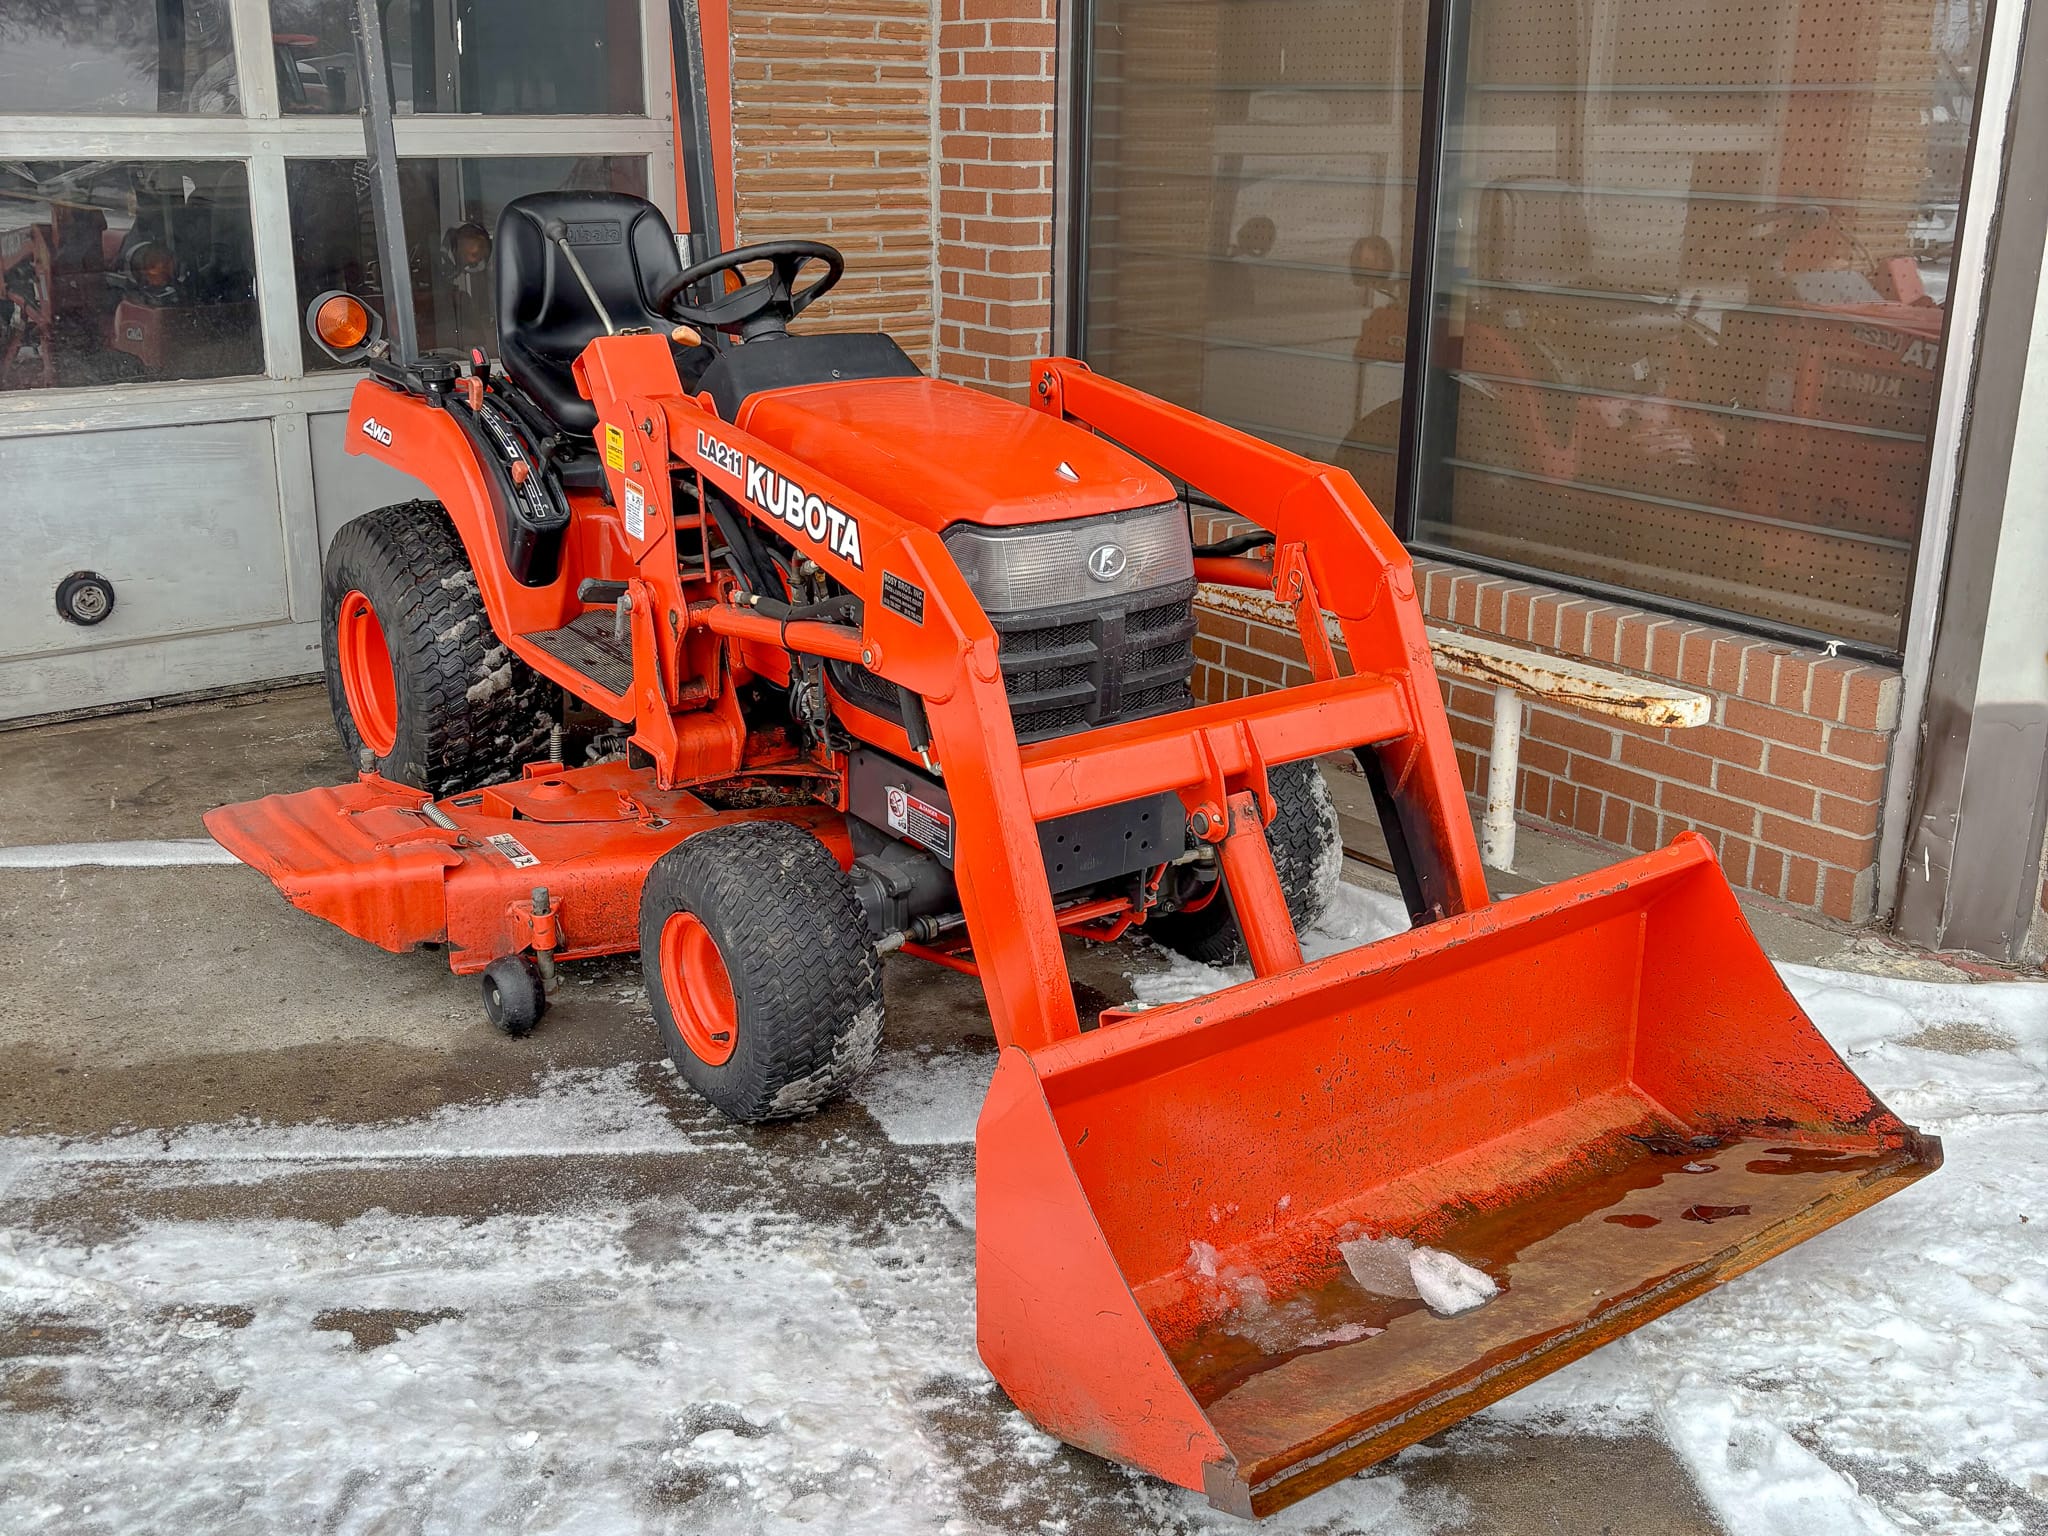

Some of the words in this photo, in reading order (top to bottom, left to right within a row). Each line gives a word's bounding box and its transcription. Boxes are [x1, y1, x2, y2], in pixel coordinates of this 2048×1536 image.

[362, 417, 393, 447] 4WD
[698, 430, 742, 478] LA211
[745, 455, 864, 572] KUBOTA
